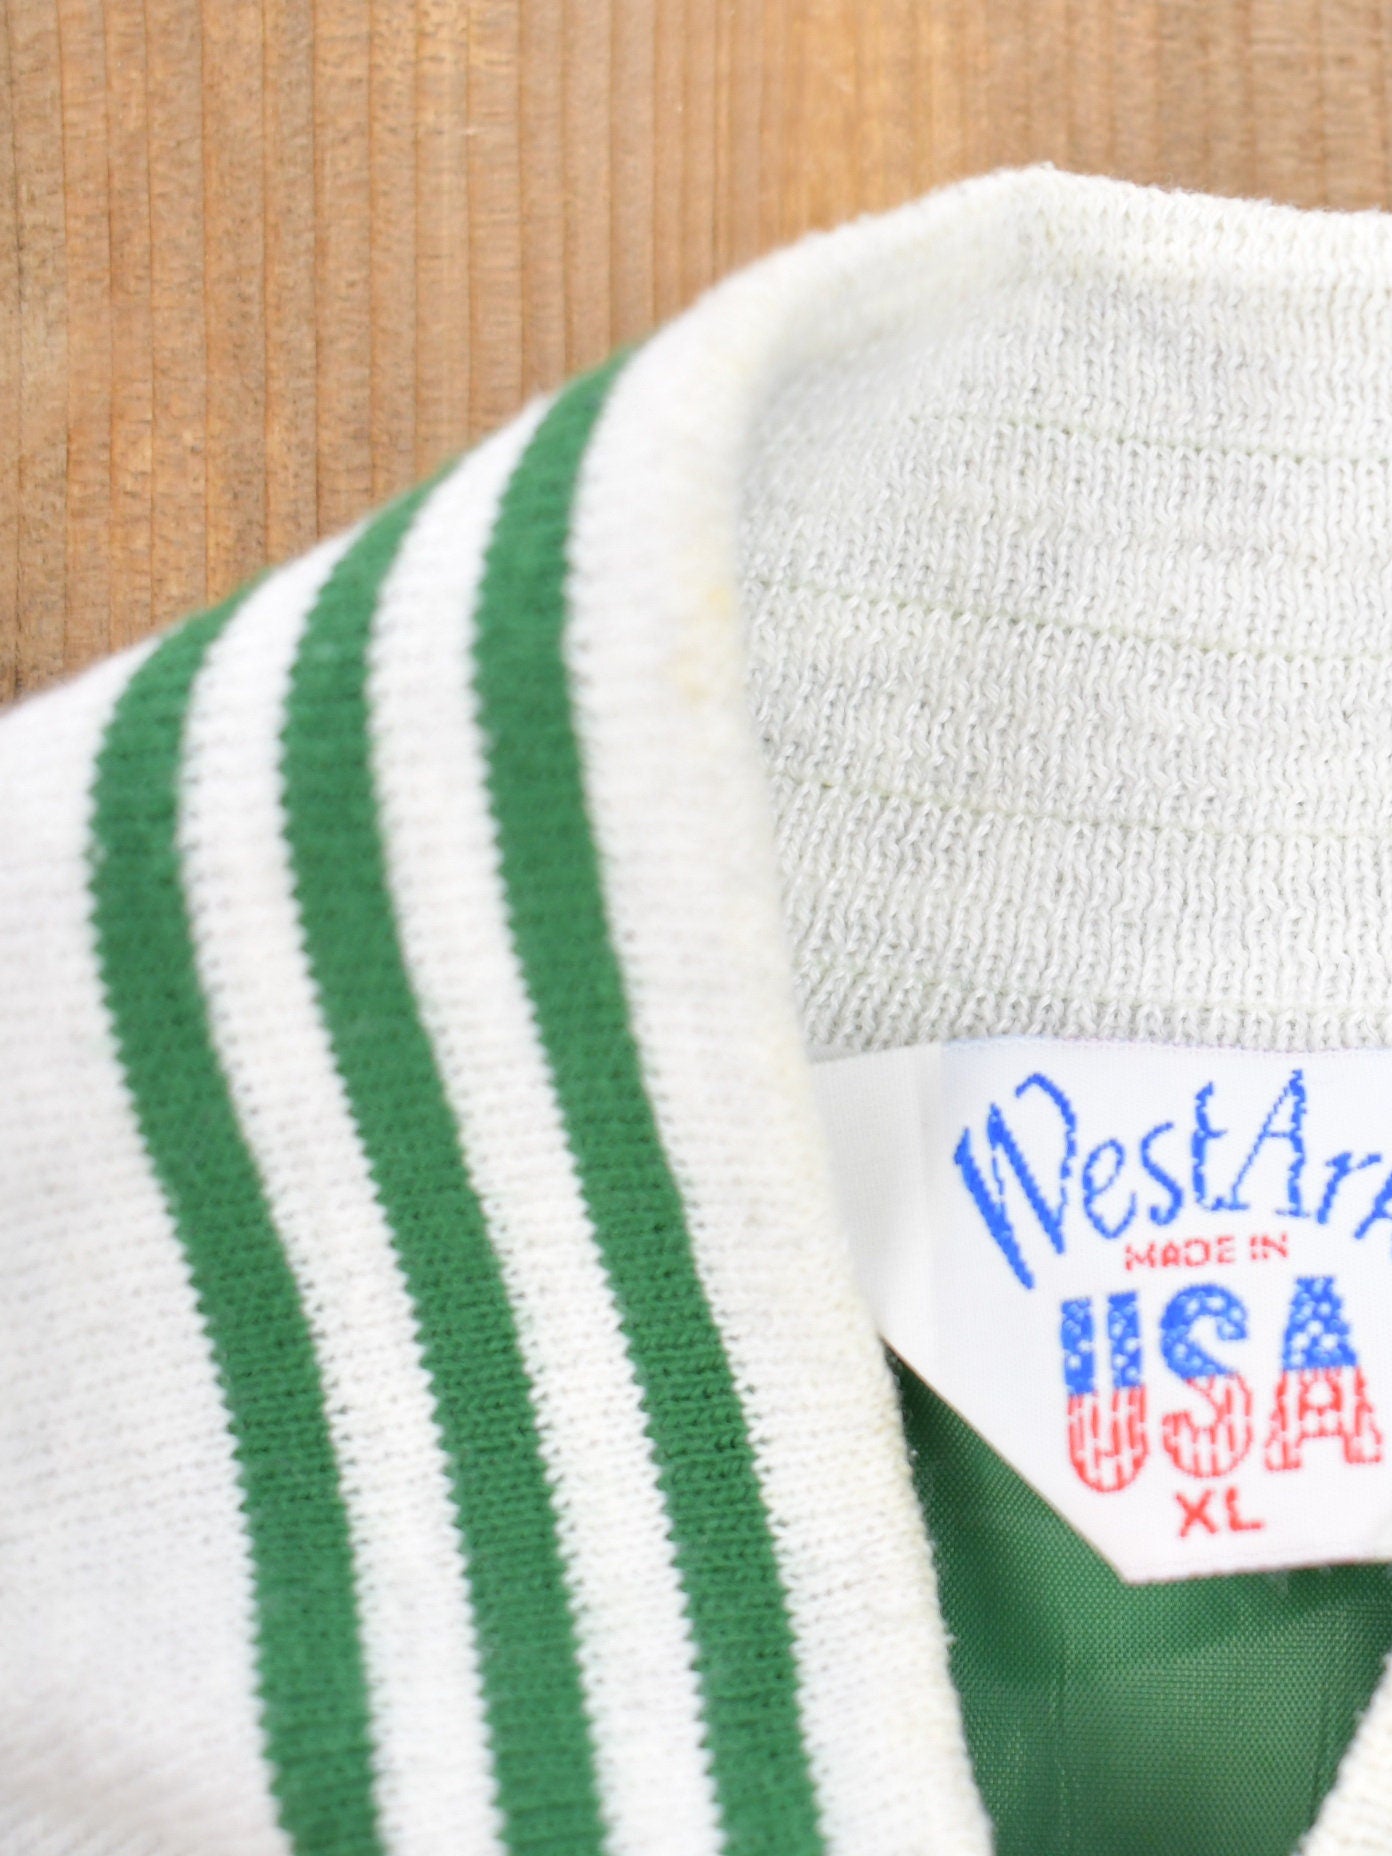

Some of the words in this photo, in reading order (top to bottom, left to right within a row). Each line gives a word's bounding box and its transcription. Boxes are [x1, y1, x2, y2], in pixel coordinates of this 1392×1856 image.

[1124, 1235, 1236, 1271] MADE
[1250, 1233, 1289, 1261] IN
[1060, 1275, 1384, 1493] USA
[1174, 1486, 1266, 1538] XL
